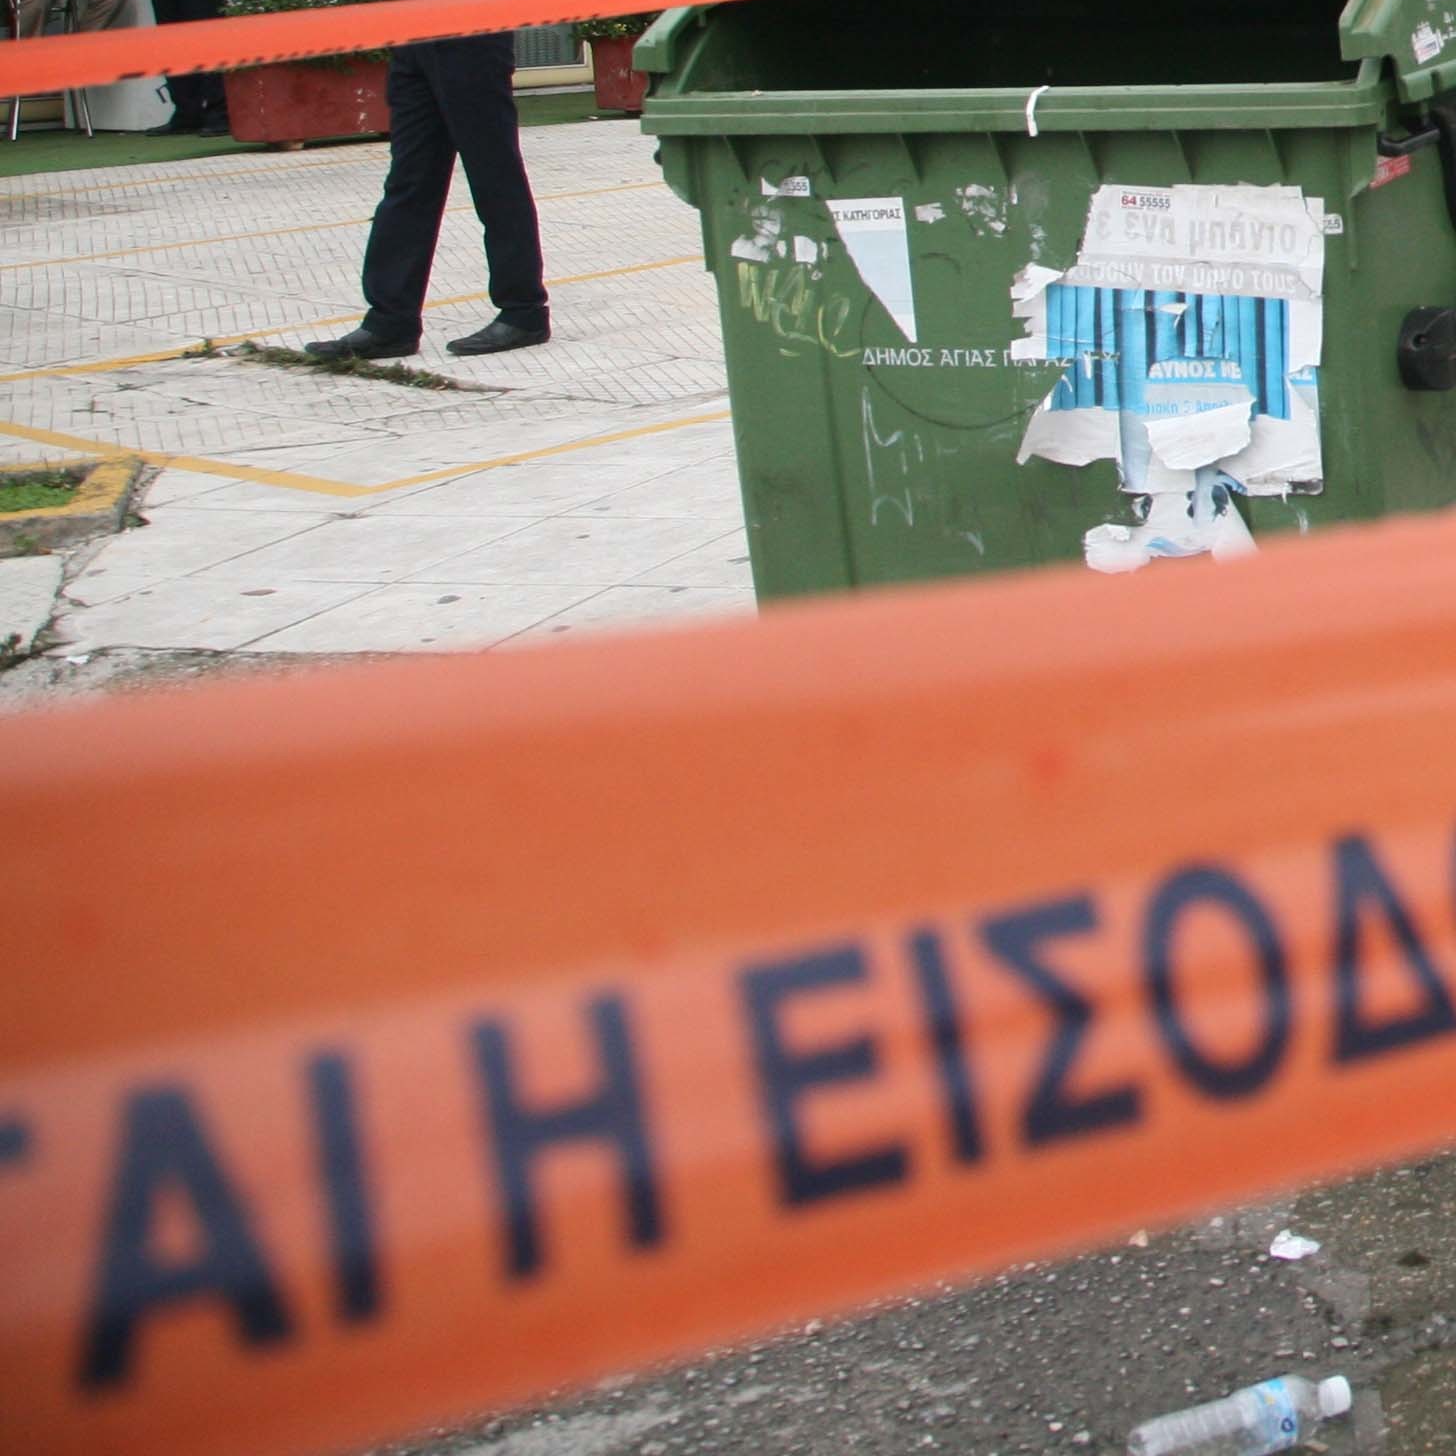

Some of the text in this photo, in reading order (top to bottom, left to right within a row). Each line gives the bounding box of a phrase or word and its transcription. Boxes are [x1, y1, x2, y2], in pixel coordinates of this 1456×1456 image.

[1121, 195, 1171, 209] 64 55555
[843, 208, 901, 222] ΚΑΤΗΓΟΡΙΑΣ
[862, 347, 933, 367] ΔΗΜΟΣ
[0, 1052, 385, 1396] ΑΙ
[466, 984, 667, 1280] Η
